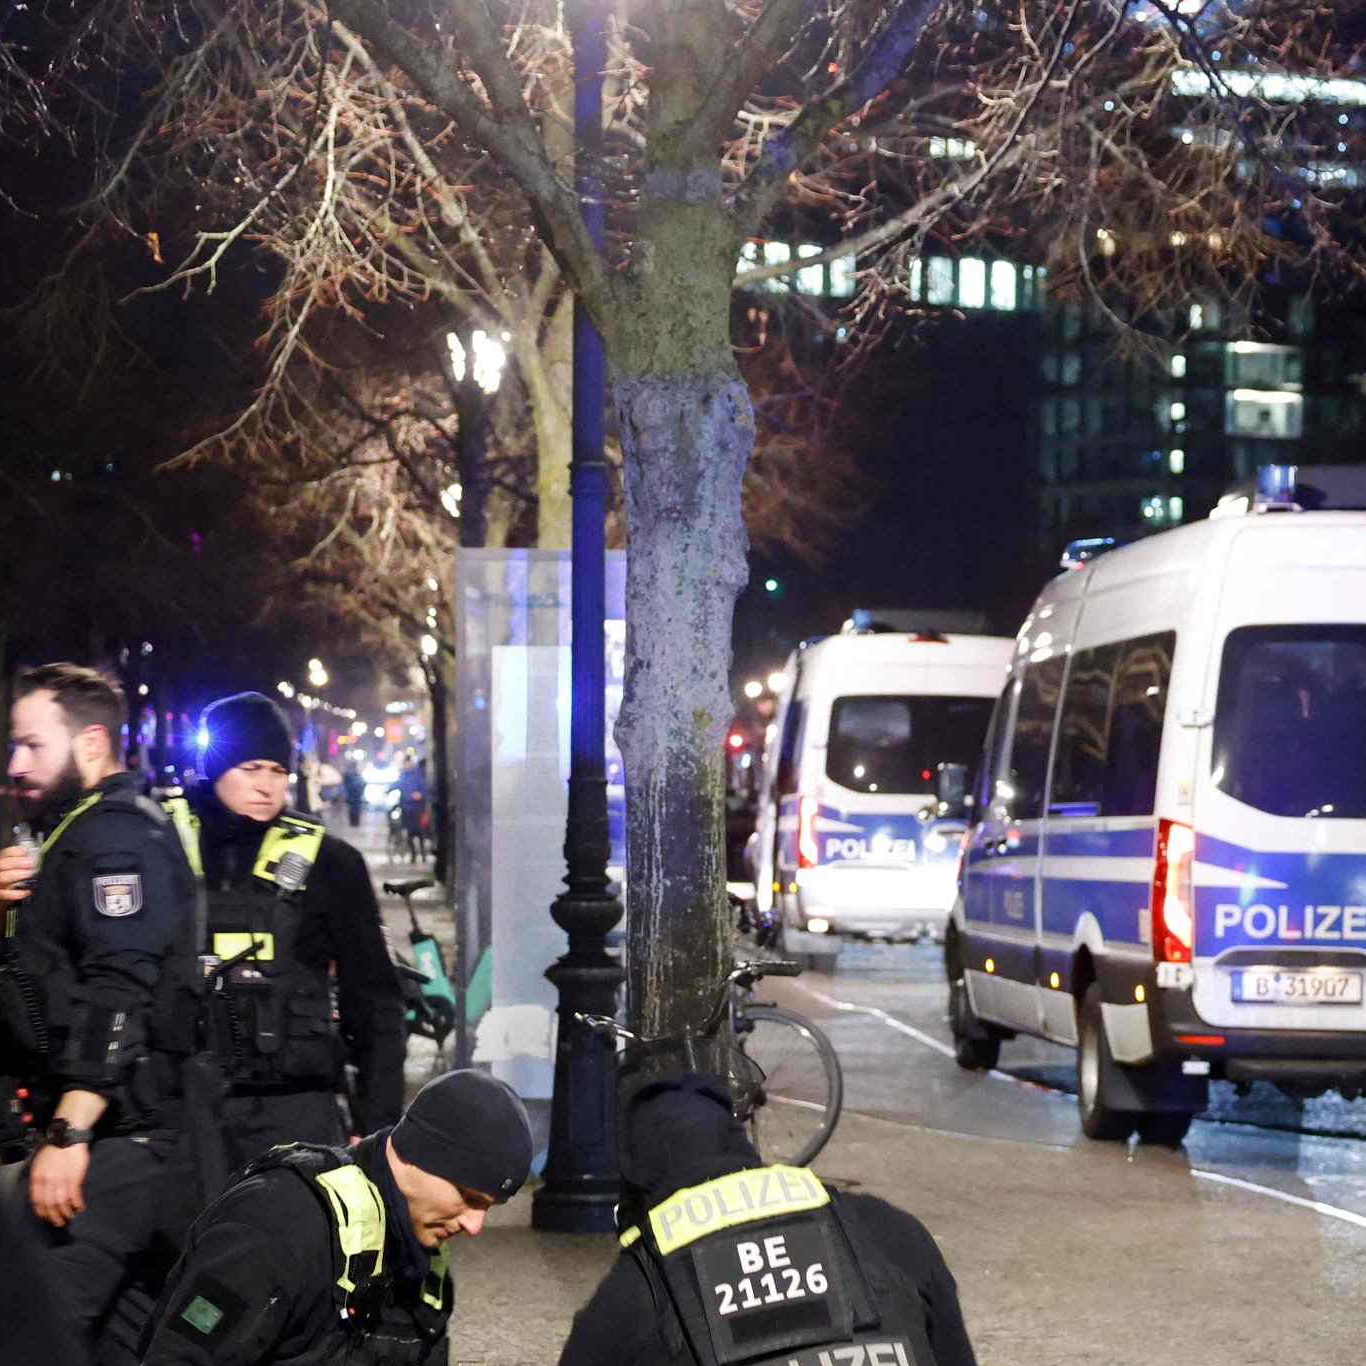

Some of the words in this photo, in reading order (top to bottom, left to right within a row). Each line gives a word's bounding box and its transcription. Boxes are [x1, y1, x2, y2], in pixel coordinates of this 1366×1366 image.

[826, 837, 916, 861] POLEI
[1256, 978, 1269, 997] B
[1285, 977, 1349, 997] 31907
[659, 1171, 820, 1243] POLIZEI
[737, 1235, 791, 1274] BE
[714, 1263, 828, 1315] 21126
